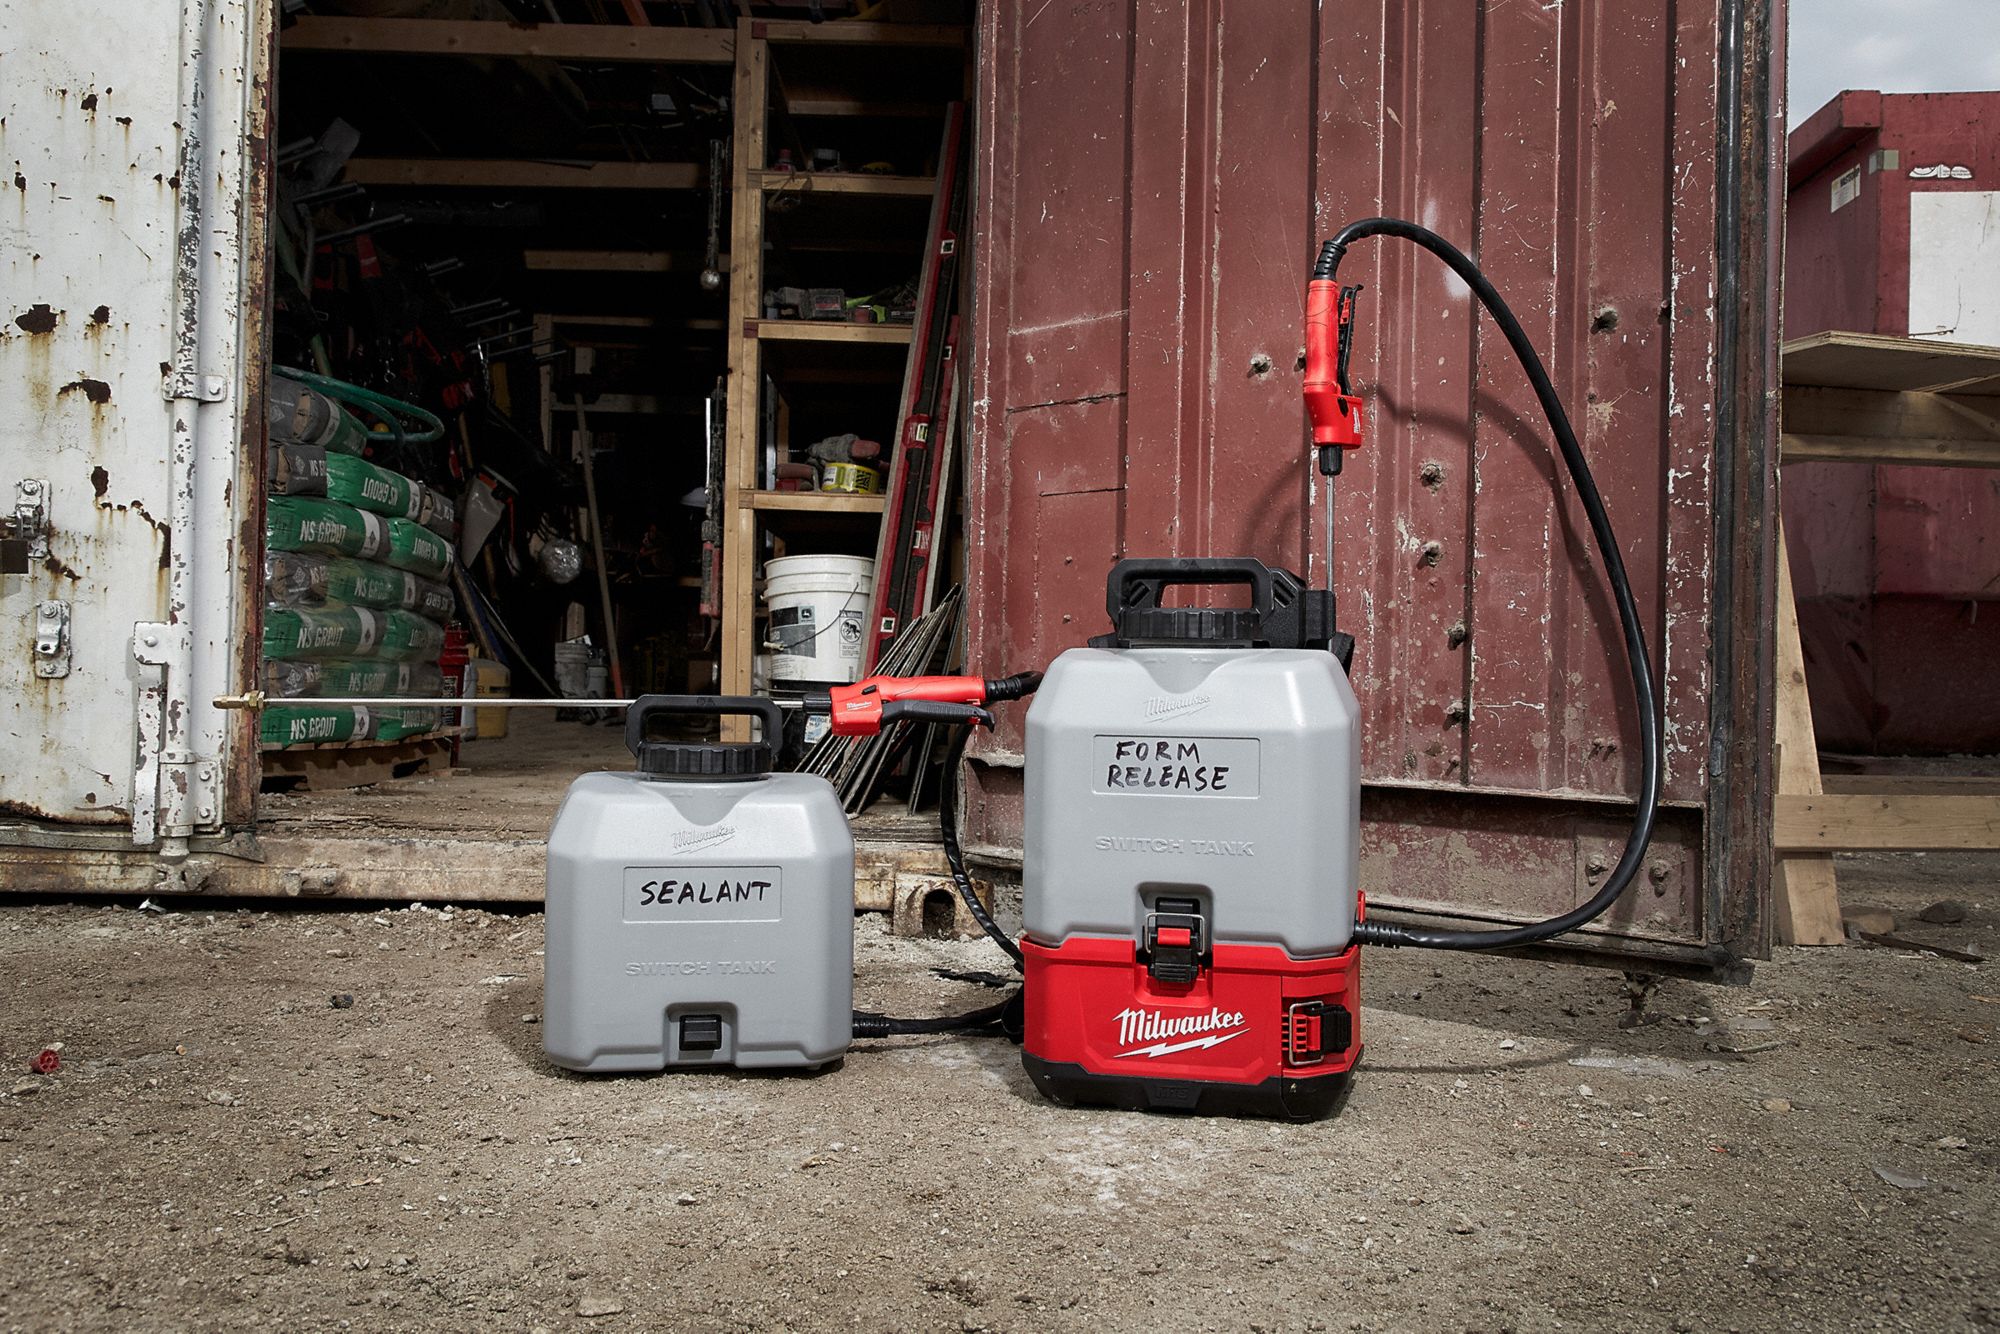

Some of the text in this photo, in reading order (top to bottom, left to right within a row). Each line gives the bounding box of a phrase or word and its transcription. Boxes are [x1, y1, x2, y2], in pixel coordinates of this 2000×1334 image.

[361, 477, 390, 503] GROUT
[300, 520, 347, 545] NS GROUT
[354, 577, 367, 597] NS
[296, 626, 344, 648] NS GROUT
[348, 672, 361, 692] NS
[1143, 695, 1212, 717] Milwaukee
[290, 716, 337, 740] NS GROUT
[1115, 740, 1201, 764] FORM
[1107, 764, 1230, 792] RELEASE
[671, 825, 738, 849] Milwaukee
[1095, 836, 1255, 857] SWITCH TANK
[640, 880, 773, 906] SEALANT
[624, 960, 777, 977] SWITCH TANK
[1111, 1006, 1247, 1047] Milwaukee
